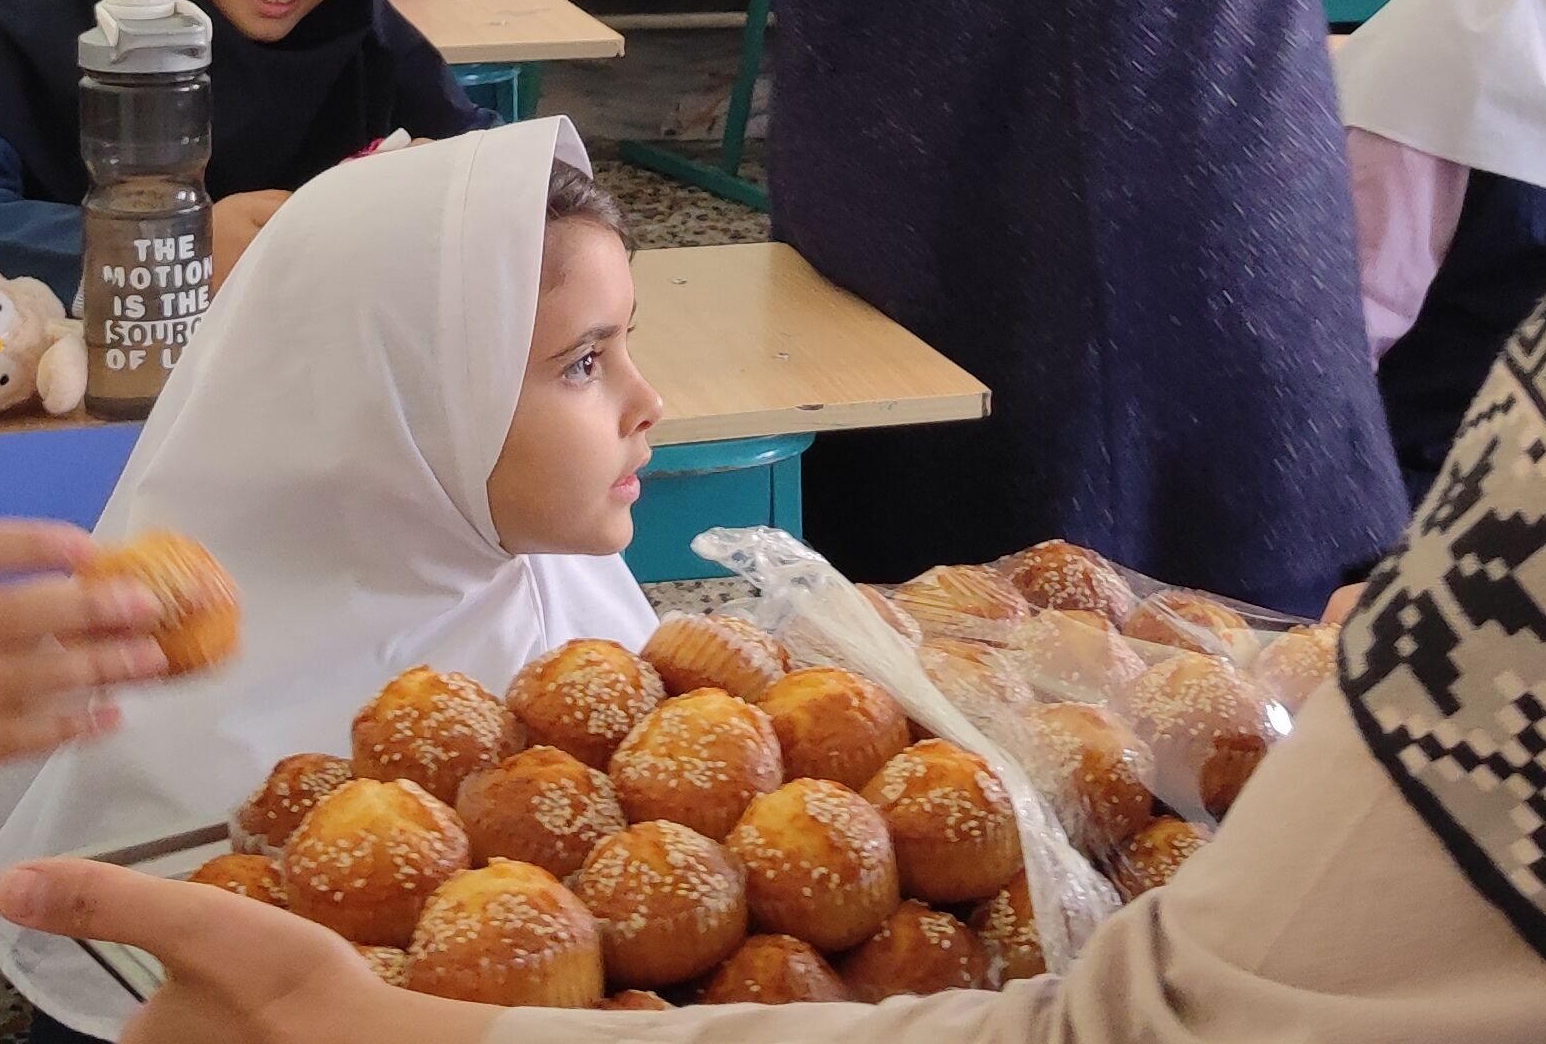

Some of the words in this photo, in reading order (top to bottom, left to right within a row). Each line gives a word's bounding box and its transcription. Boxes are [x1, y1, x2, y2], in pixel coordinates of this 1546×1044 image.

[133, 234, 195, 262] THE
[102, 255, 213, 290] MOTION
[113, 294, 146, 319] IS
[160, 285, 210, 317] THE
[109, 316, 202, 347] SOUR
[106, 348, 147, 371] OF
